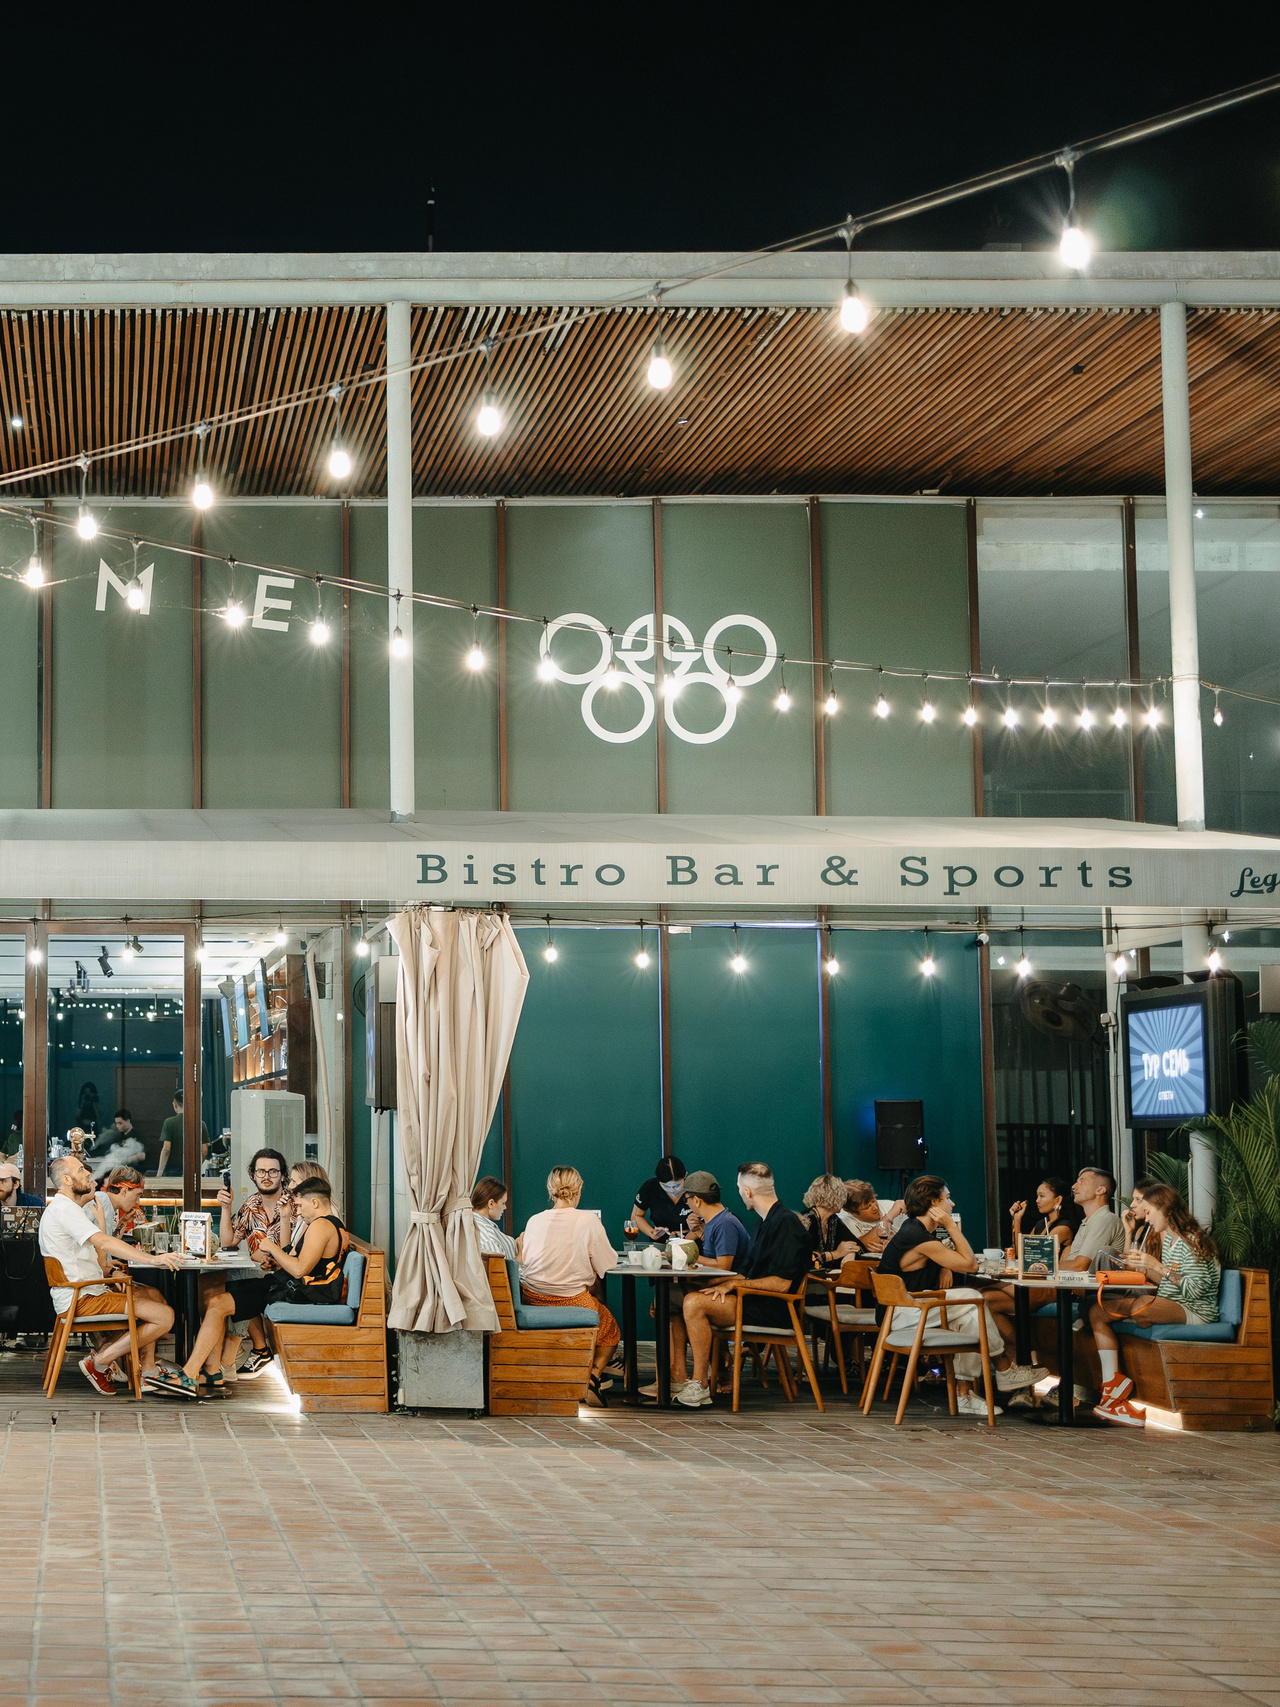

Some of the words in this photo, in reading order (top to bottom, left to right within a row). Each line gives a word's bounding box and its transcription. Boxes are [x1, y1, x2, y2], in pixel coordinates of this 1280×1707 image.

[416, 853, 626, 886] Bistro
[666, 855, 780, 886] Bar
[820, 855, 859, 886] &
[899, 856, 1133, 896] Sports
